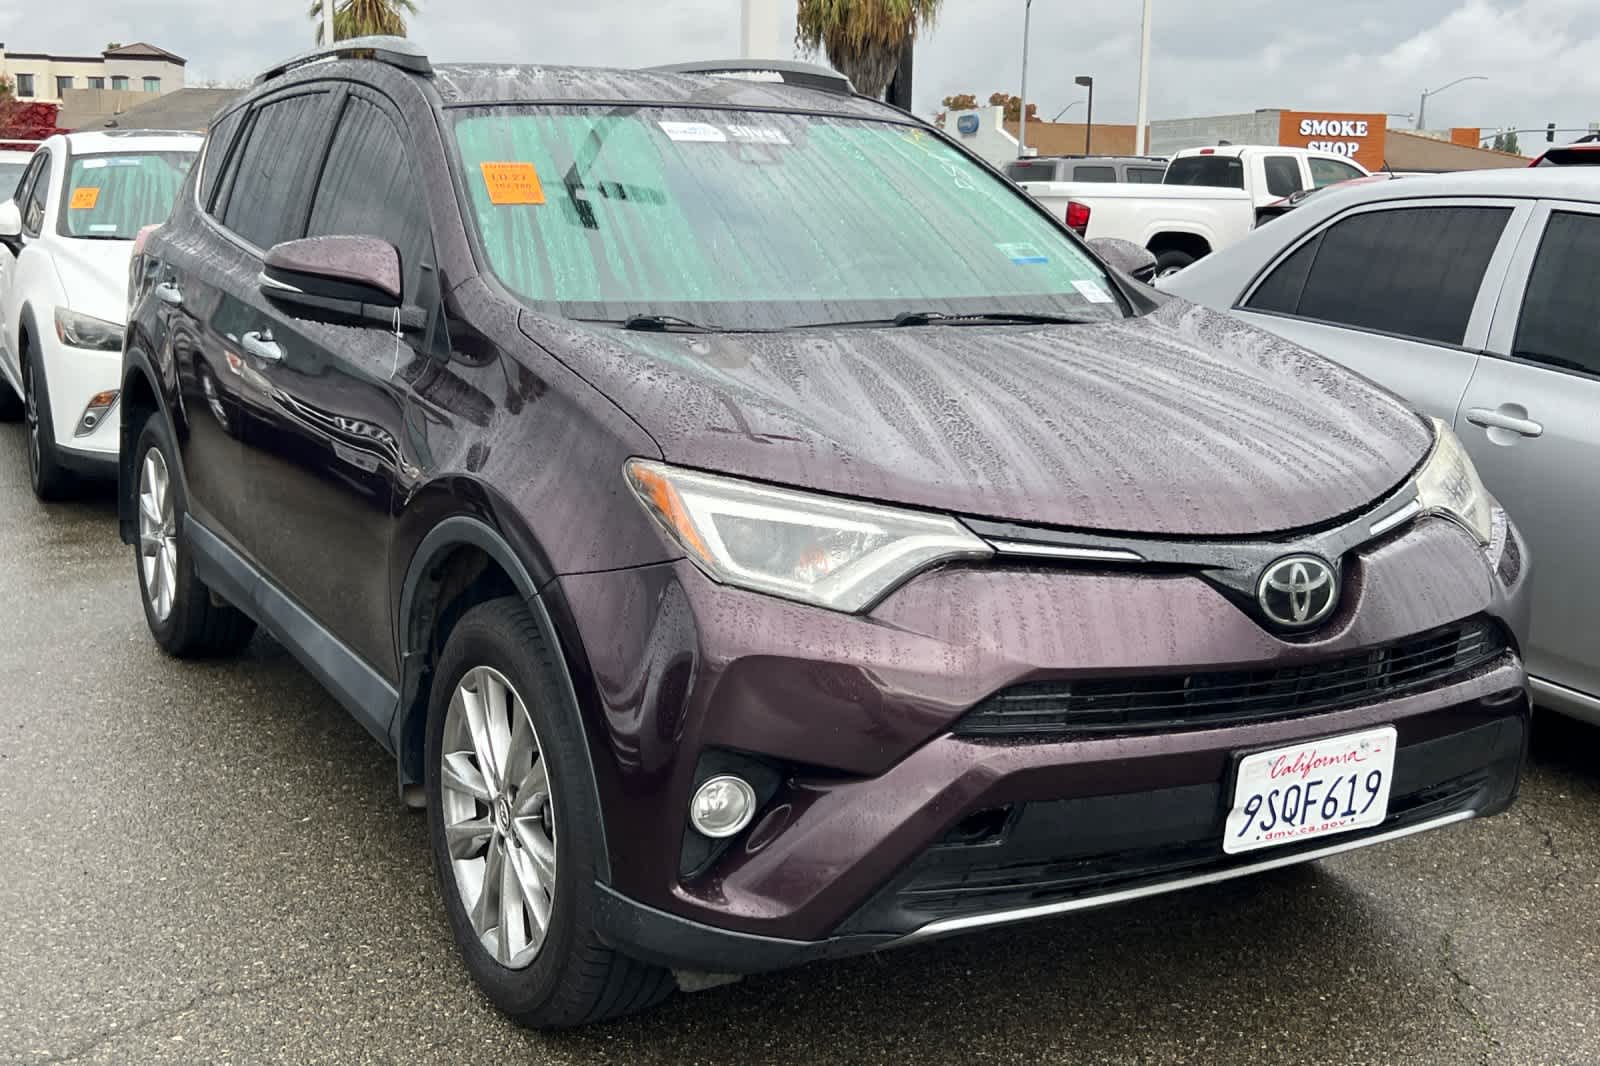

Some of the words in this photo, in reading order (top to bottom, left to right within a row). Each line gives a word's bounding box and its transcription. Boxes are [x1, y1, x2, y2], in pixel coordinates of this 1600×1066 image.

[1299, 119, 1368, 136] SMOKE
[1307, 141, 1359, 157] SHOP
[1270, 749, 1366, 779] California
[1237, 769, 1382, 838] 9SQF619
[1264, 819, 1347, 842] dmv.ca.gov
